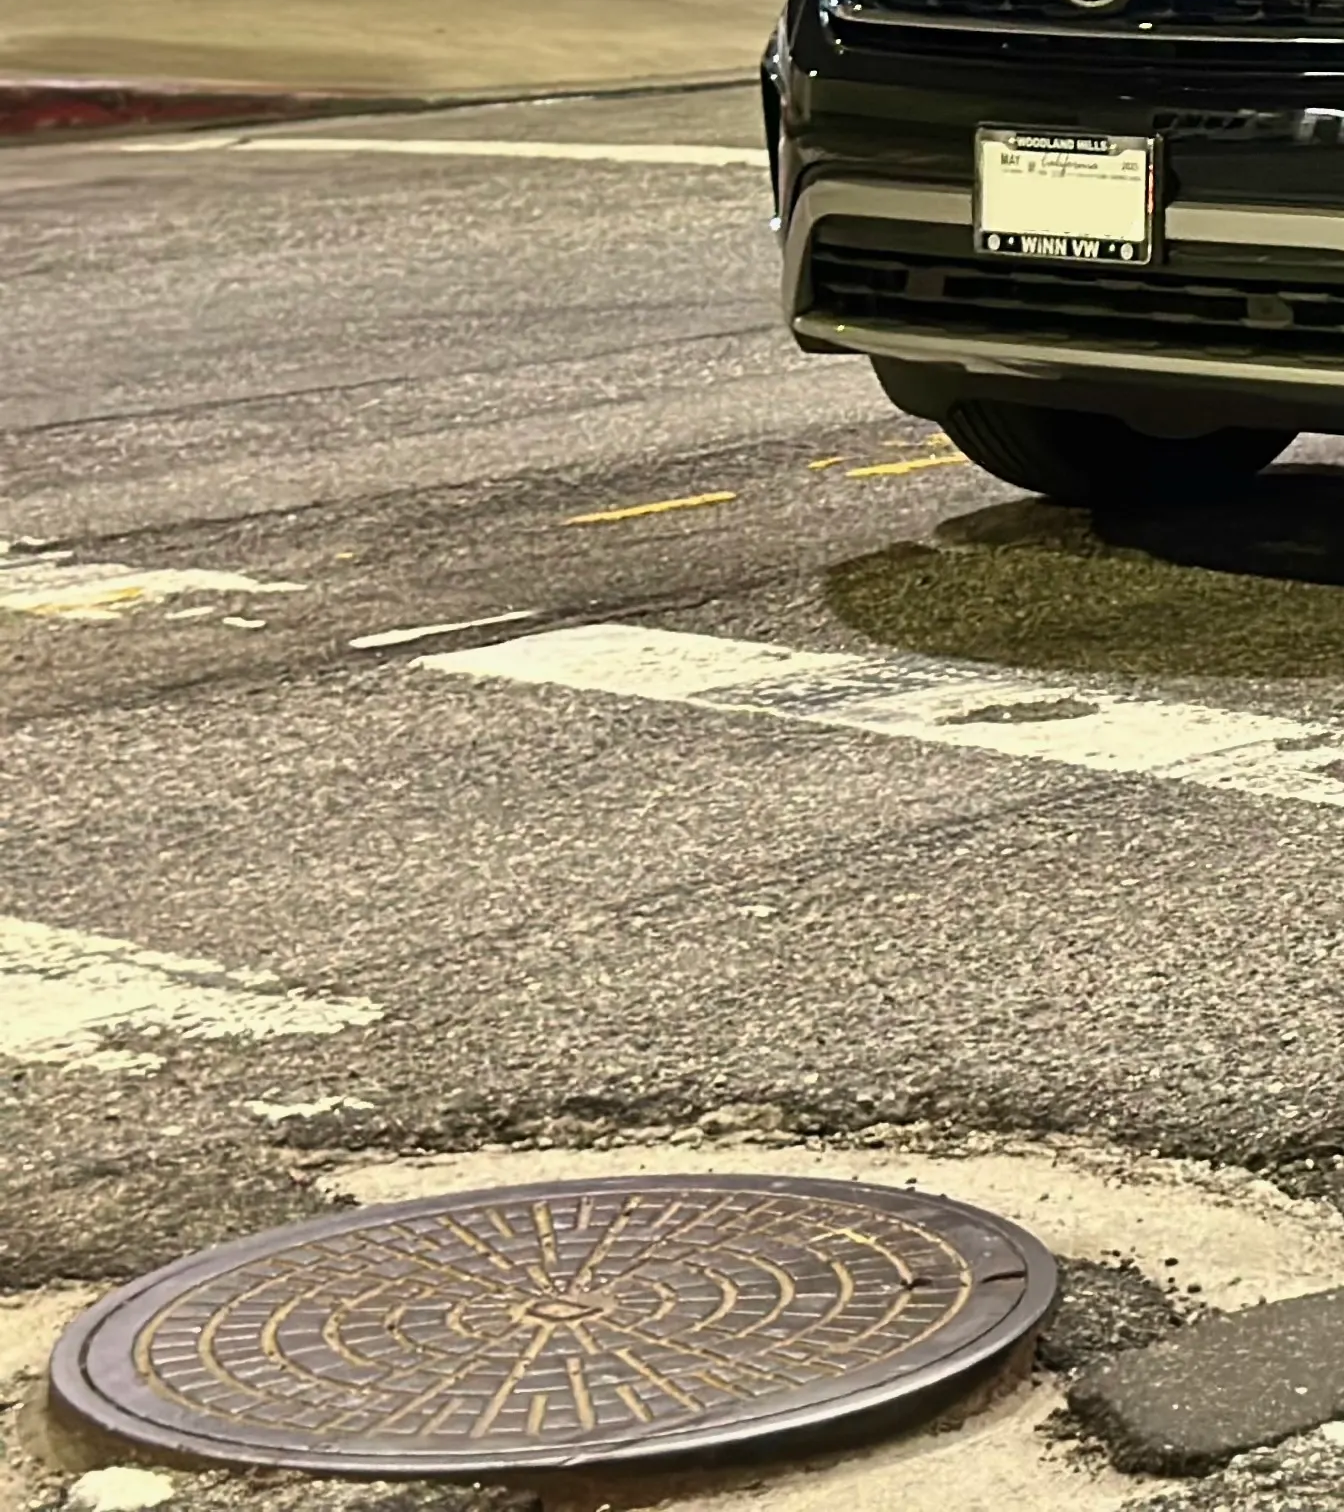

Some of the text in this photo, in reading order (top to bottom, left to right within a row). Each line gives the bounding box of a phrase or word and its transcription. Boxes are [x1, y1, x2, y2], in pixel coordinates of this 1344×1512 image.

[1016, 135, 1075, 150] WOODLAND
[1020, 235, 1100, 258] WINN VW
